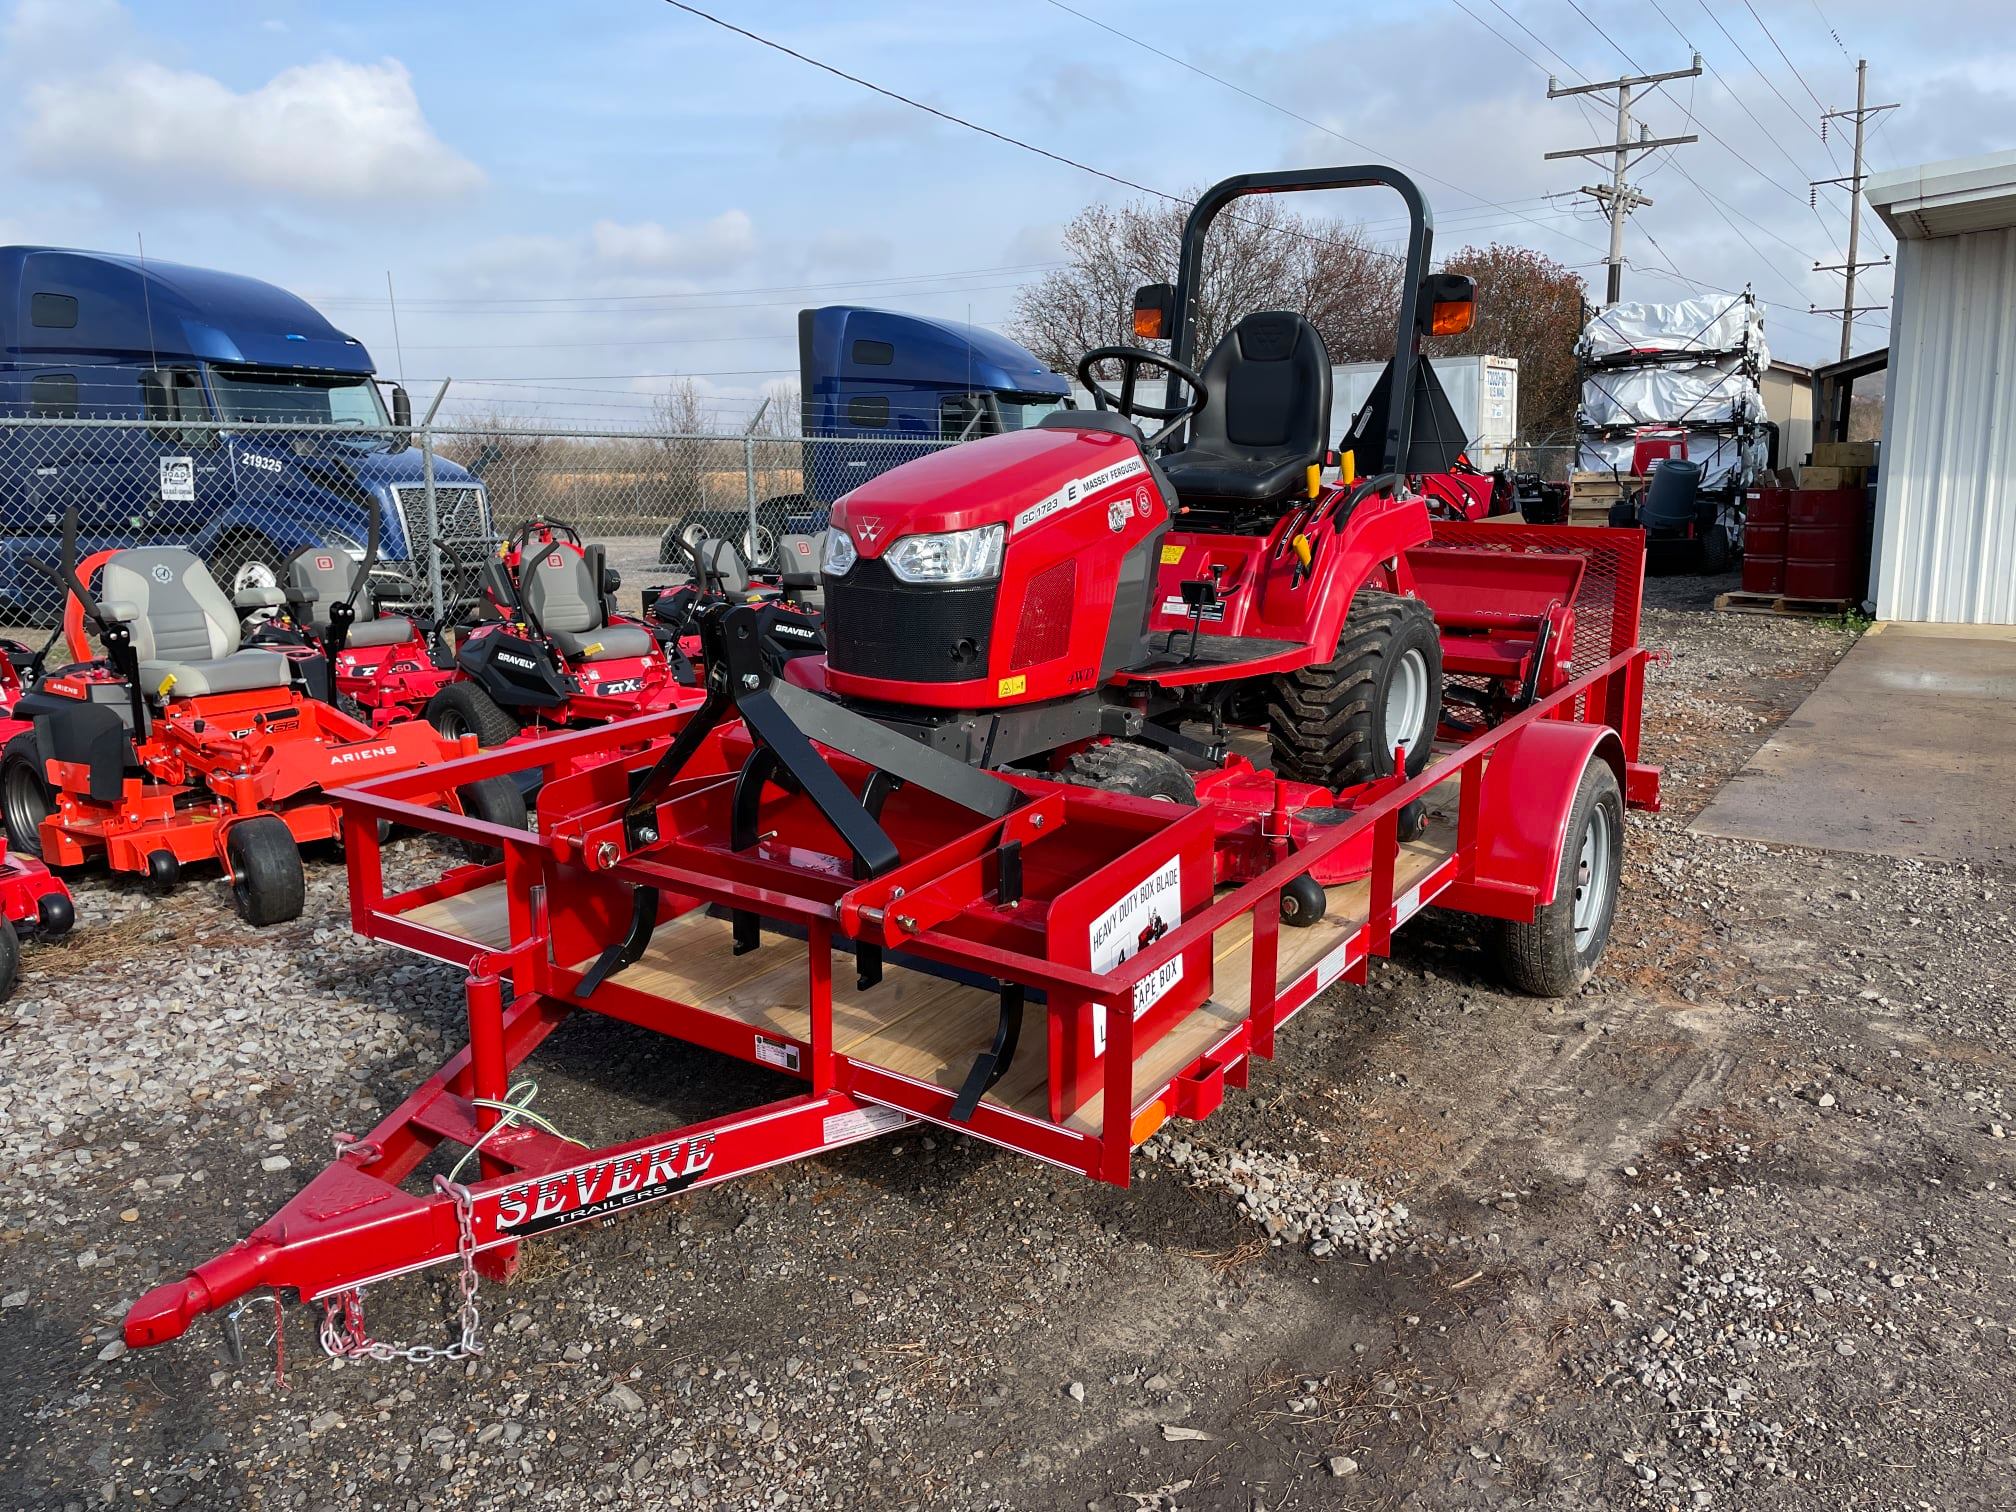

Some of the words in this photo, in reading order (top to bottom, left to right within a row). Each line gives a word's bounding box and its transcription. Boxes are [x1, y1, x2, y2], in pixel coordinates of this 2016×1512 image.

[242, 452, 283, 473] 219325
[1082, 474, 1110, 492] MASSEY
[1110, 460, 1142, 480] FERGUSON
[1068, 485, 1077, 501] E
[775, 624, 815, 638] GRAVELY
[497, 652, 536, 670] GRAVELY
[52, 683, 79, 695] ARIENS
[330, 746, 397, 765] ARIENS
[1093, 911, 1117, 952] HEAVY
[1119, 891, 1138, 922] DUTY
[1140, 881, 1155, 904] BOX
[1156, 868, 1178, 893] BLADE
[1159, 957, 1177, 989] BOX
[496, 1132, 716, 1230] SEVERE
[554, 1185, 668, 1223] TRAILERS
